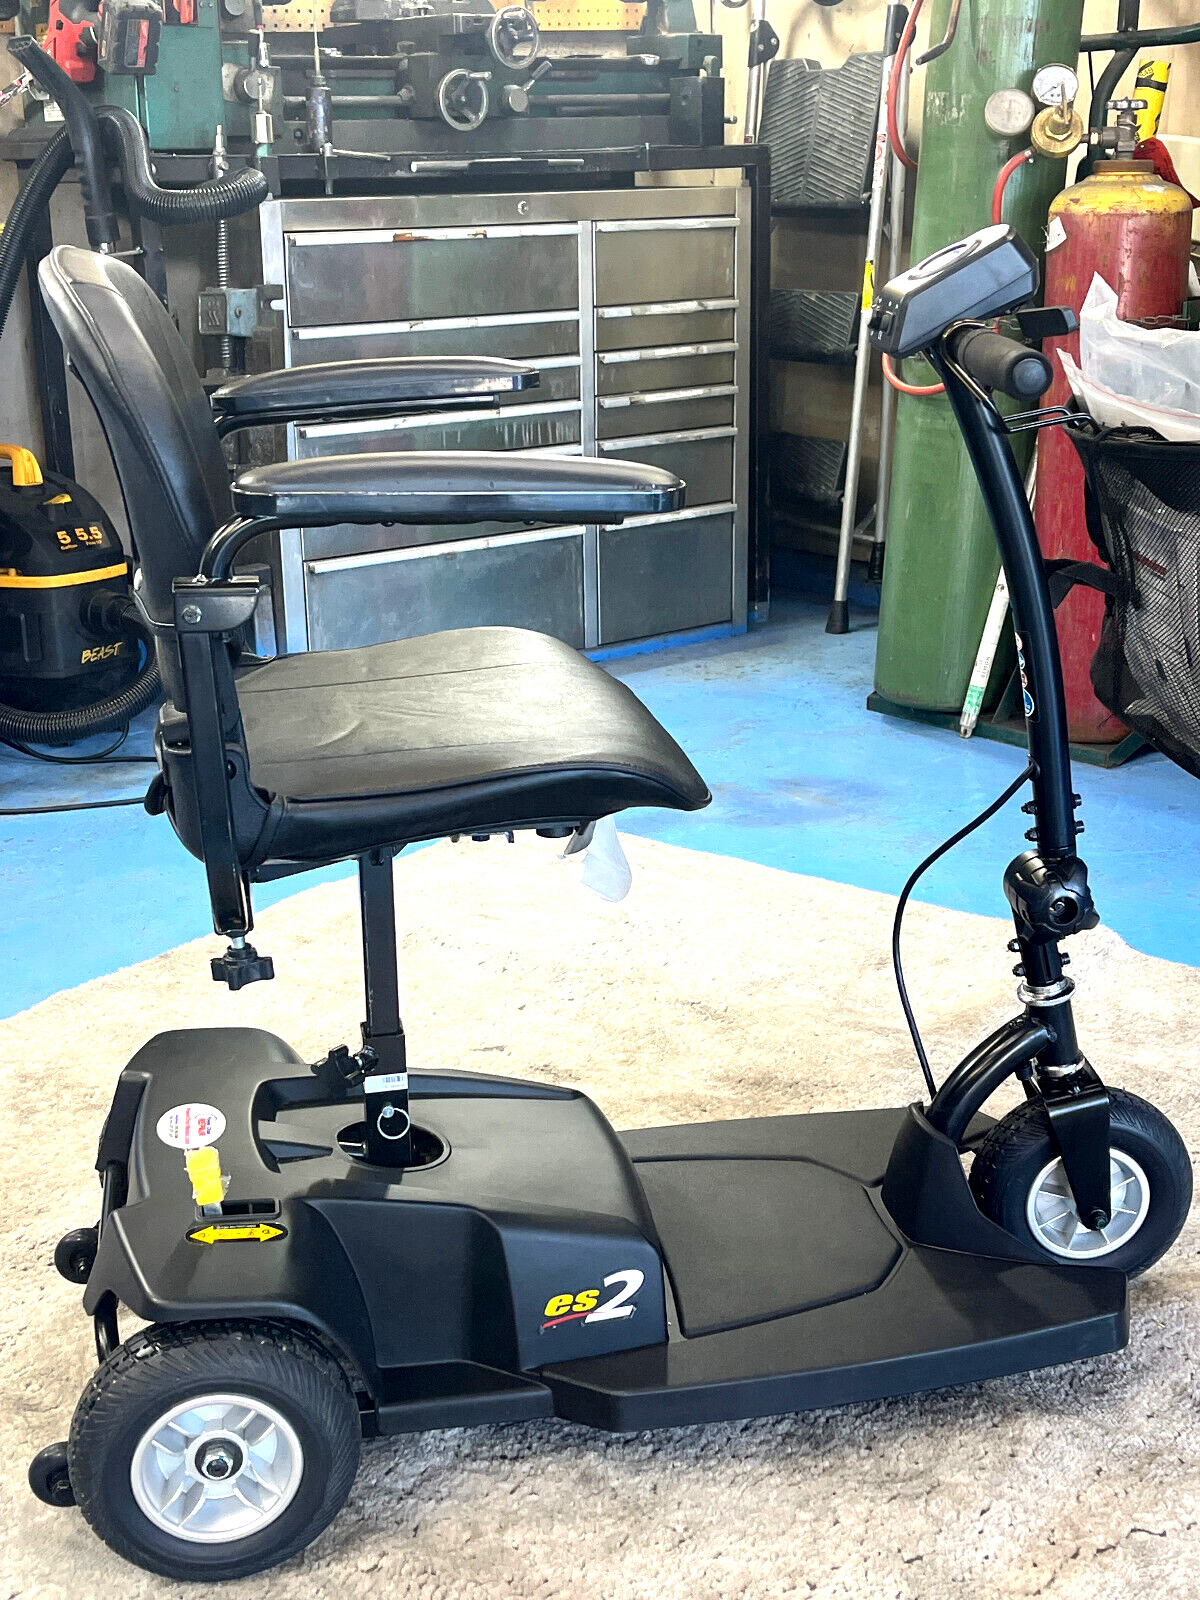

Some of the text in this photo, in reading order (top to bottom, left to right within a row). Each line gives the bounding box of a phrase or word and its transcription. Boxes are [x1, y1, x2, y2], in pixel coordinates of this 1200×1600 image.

[56, 530, 72, 545] 5
[74, 525, 103, 541] 5.5
[81, 641, 124, 664] BEAST
